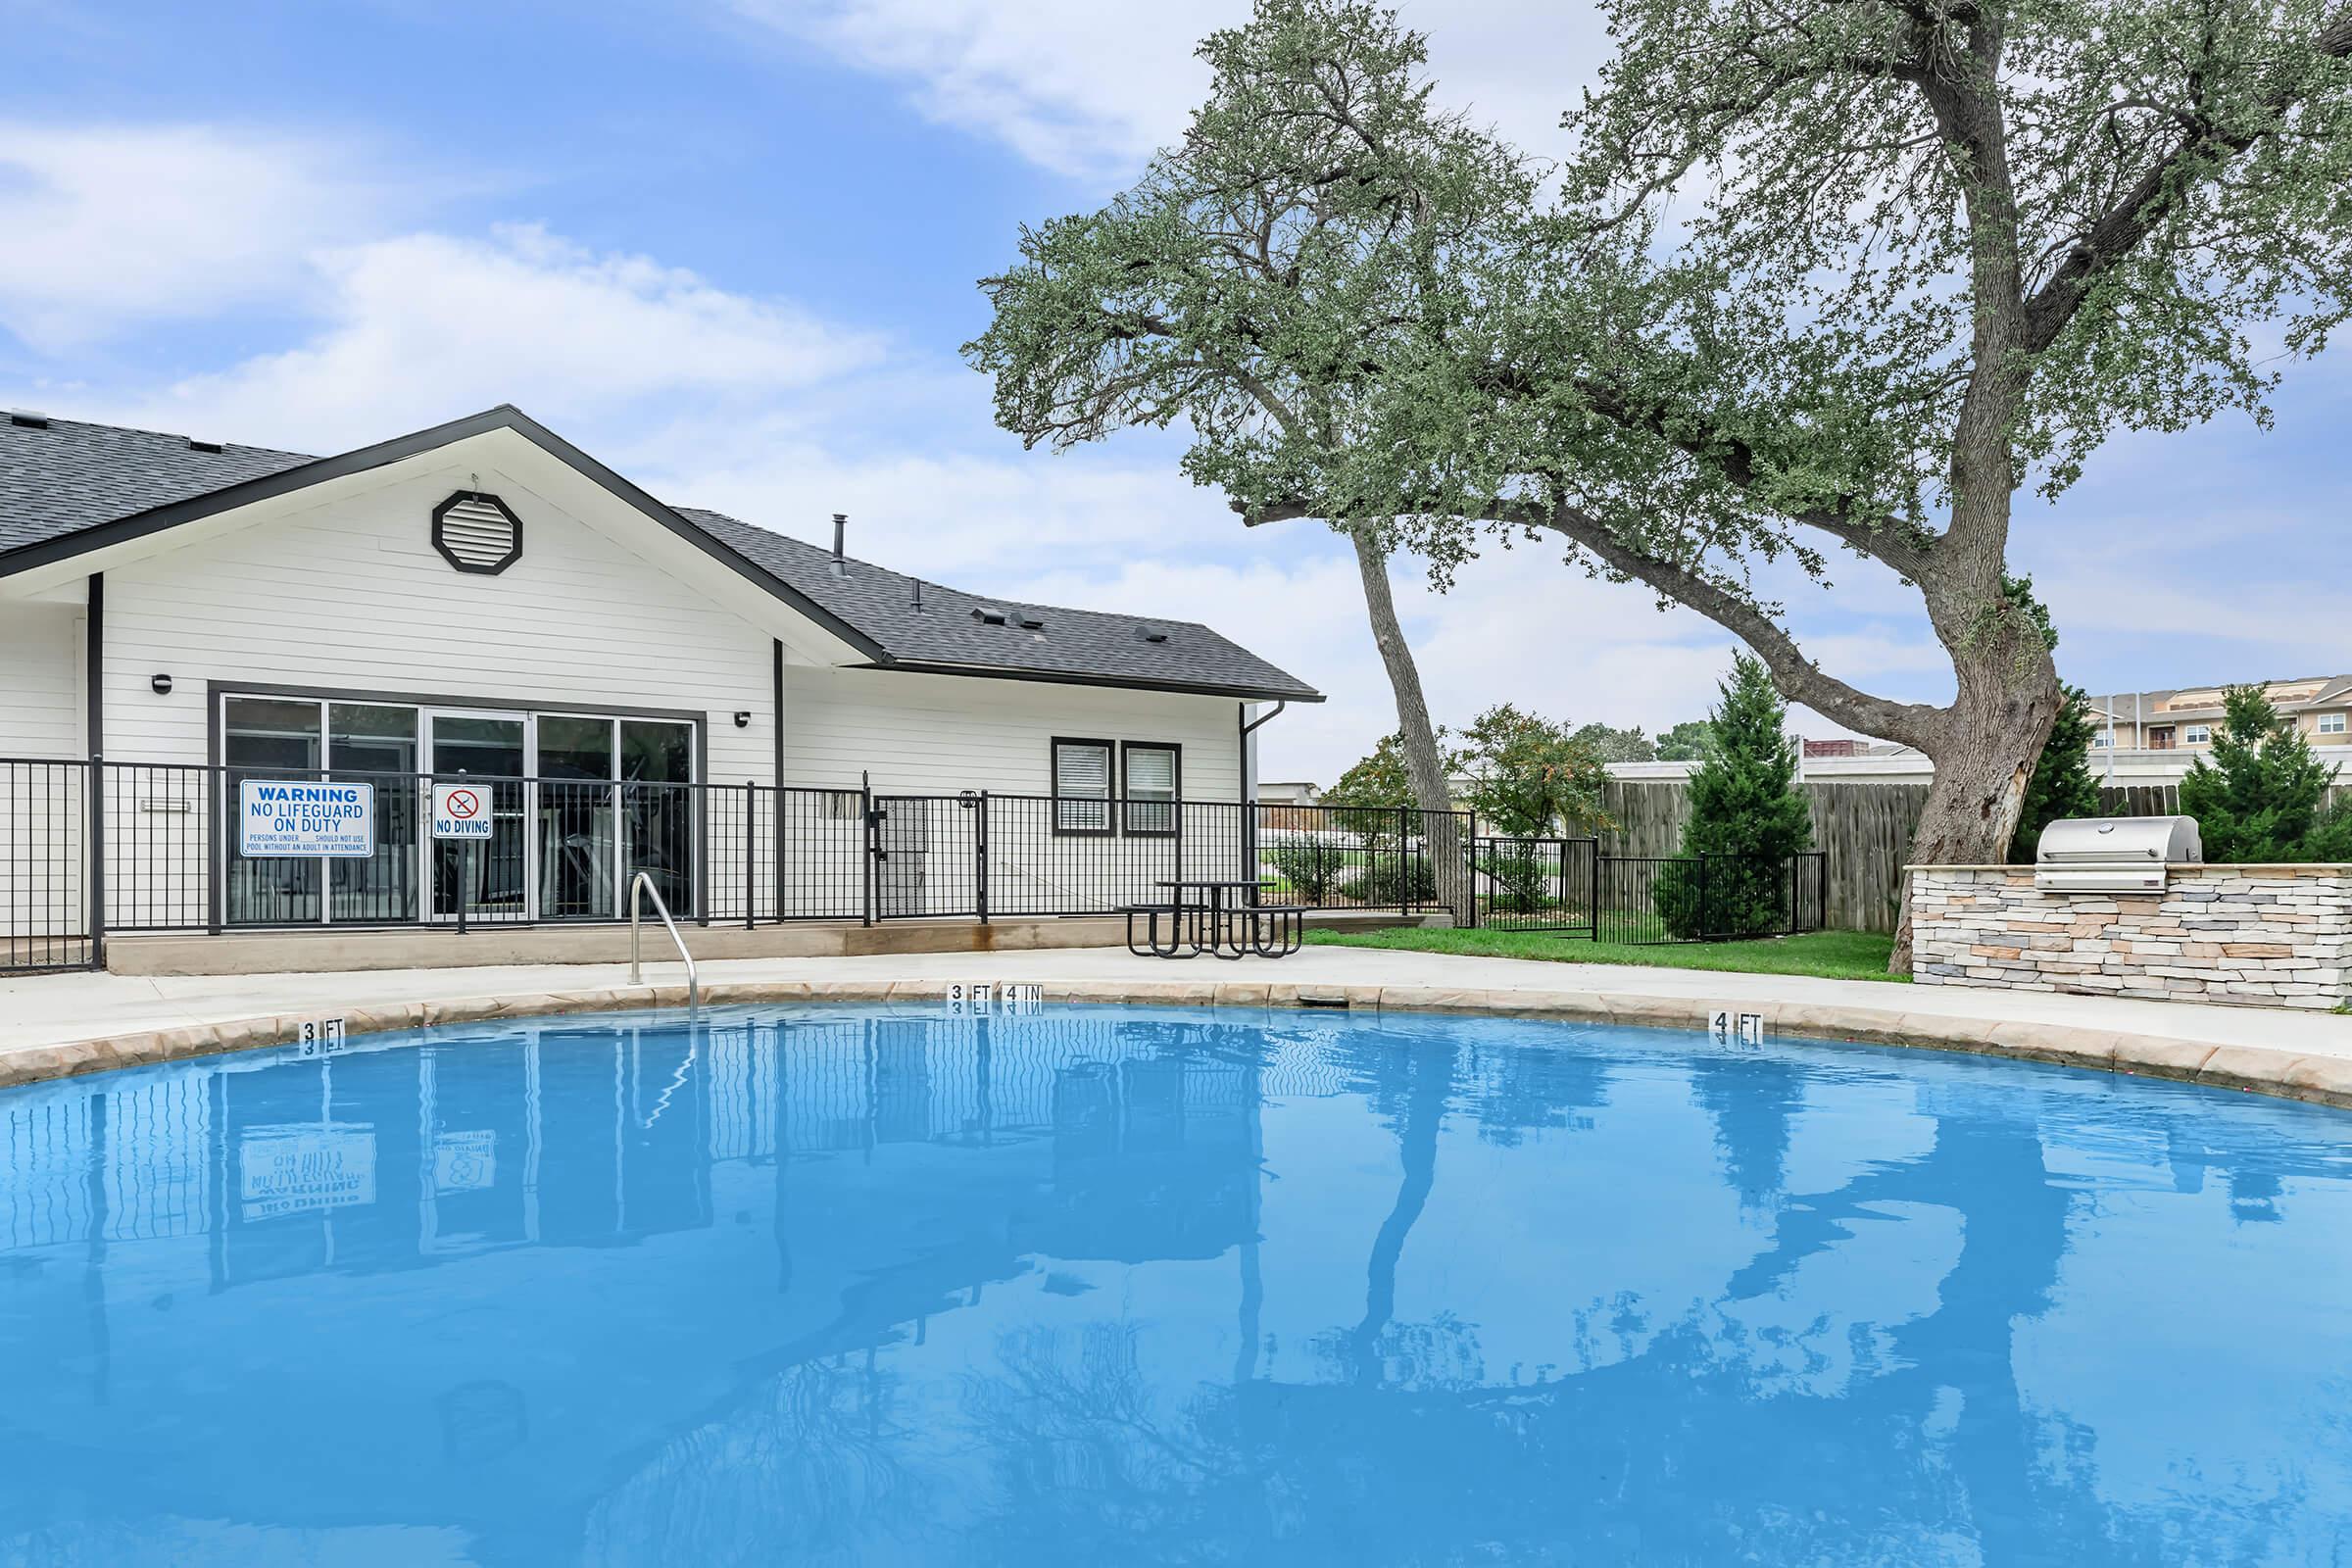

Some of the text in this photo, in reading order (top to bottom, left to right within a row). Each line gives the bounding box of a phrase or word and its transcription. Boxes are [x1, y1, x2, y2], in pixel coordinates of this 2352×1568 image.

[258, 787, 358, 803] WARNING
[251, 803, 364, 819] NO LIFEGUARD
[273, 817, 341, 833] ON DUTY
[436, 819, 489, 833] NO DIVING
[249, 833, 364, 843] PERSONS UNDER SHOULD NOT USE
[293, 843, 302, 852] AN
[302, 843, 322, 852] ADULT
[330, 843, 367, 852] ATTENDANCE
[952, 985, 1040, 1001] 3 FT 4 IN
[304, 1019, 343, 1040] 3 FT
[1715, 1012, 1761, 1032] 4 FT
